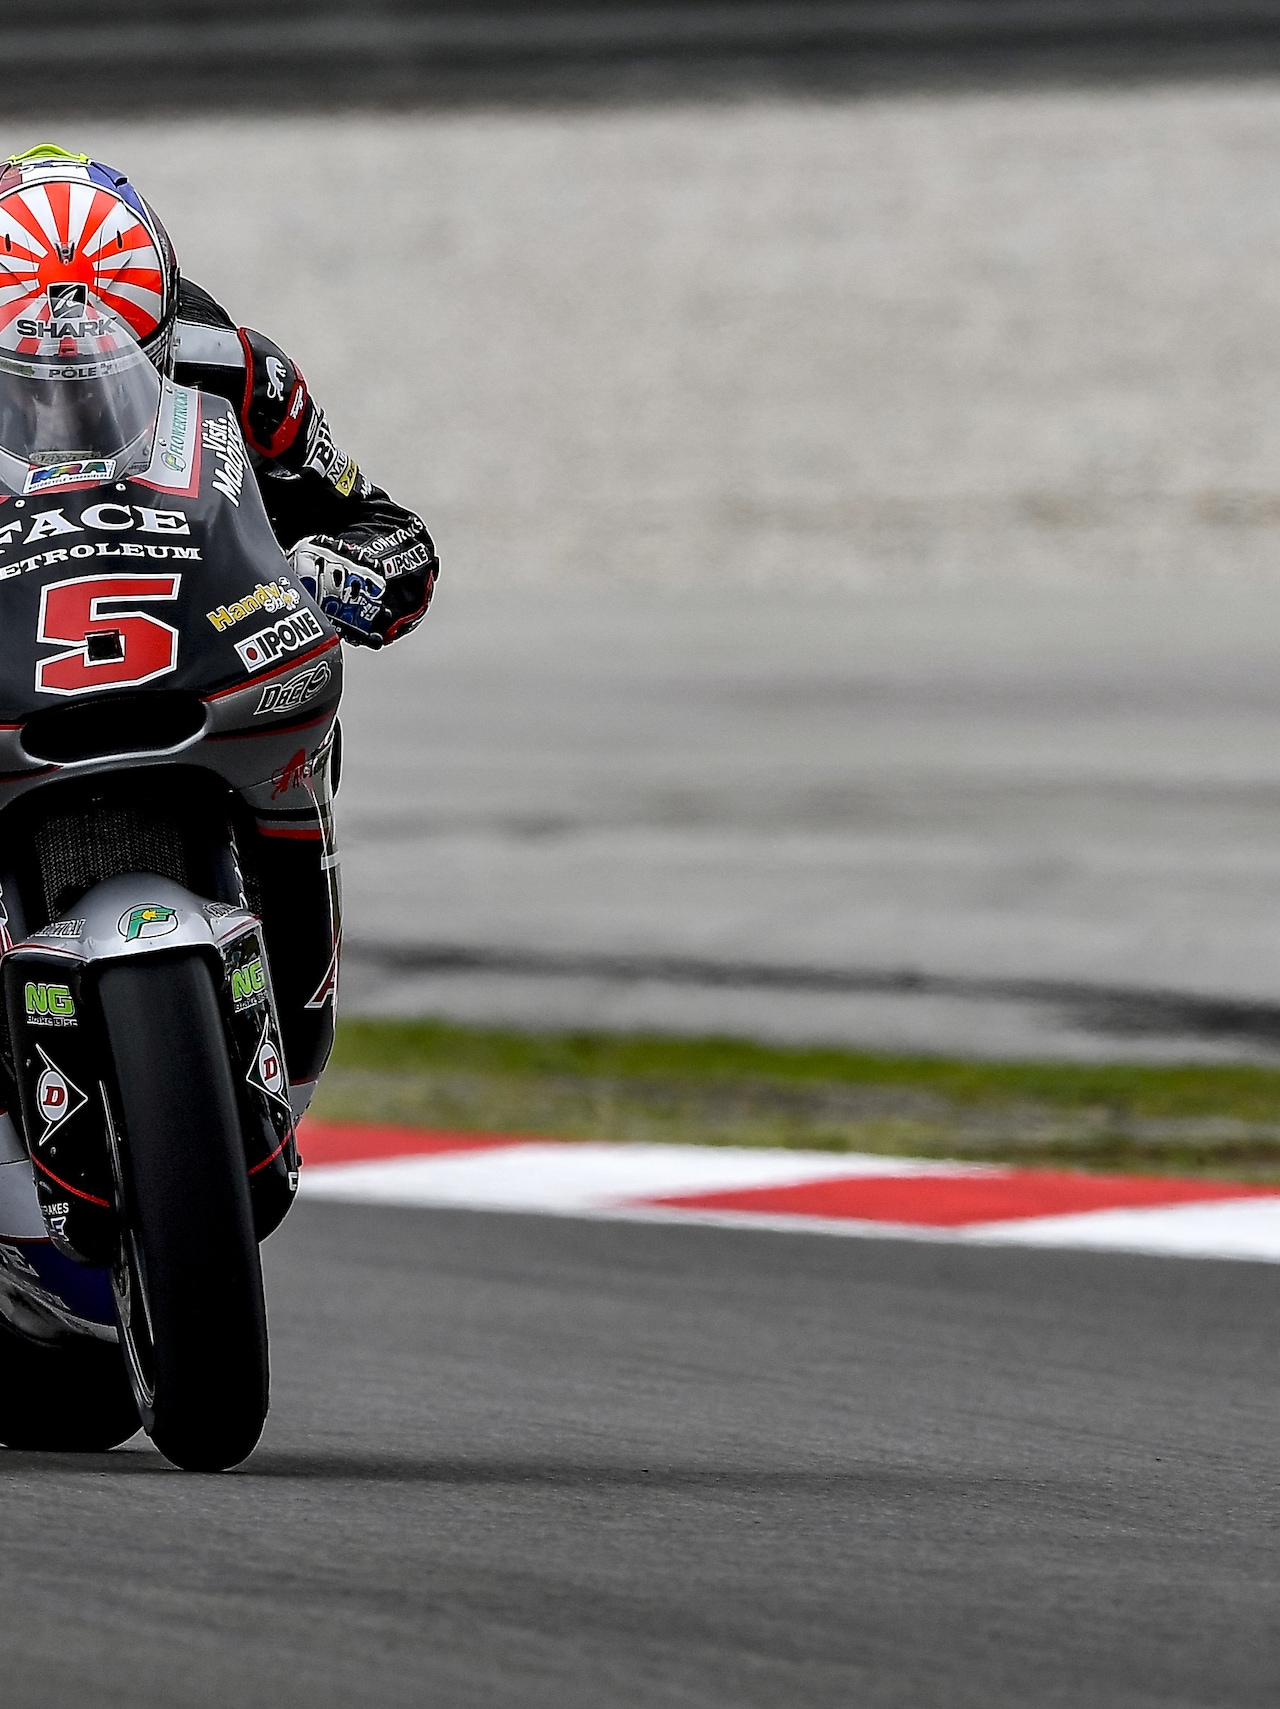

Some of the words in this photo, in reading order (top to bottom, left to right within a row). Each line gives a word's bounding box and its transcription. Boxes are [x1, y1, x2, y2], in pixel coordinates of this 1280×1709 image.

[16, 318, 117, 339] SHARK
[201, 419, 228, 453] Visit
[205, 581, 281, 633] Handy
[34, 572, 183, 697] 5
[254, 612, 321, 660] IPONE
[25, 981, 76, 1017] NG
[231, 957, 267, 1003] NG
[43, 1085, 66, 1107] D
